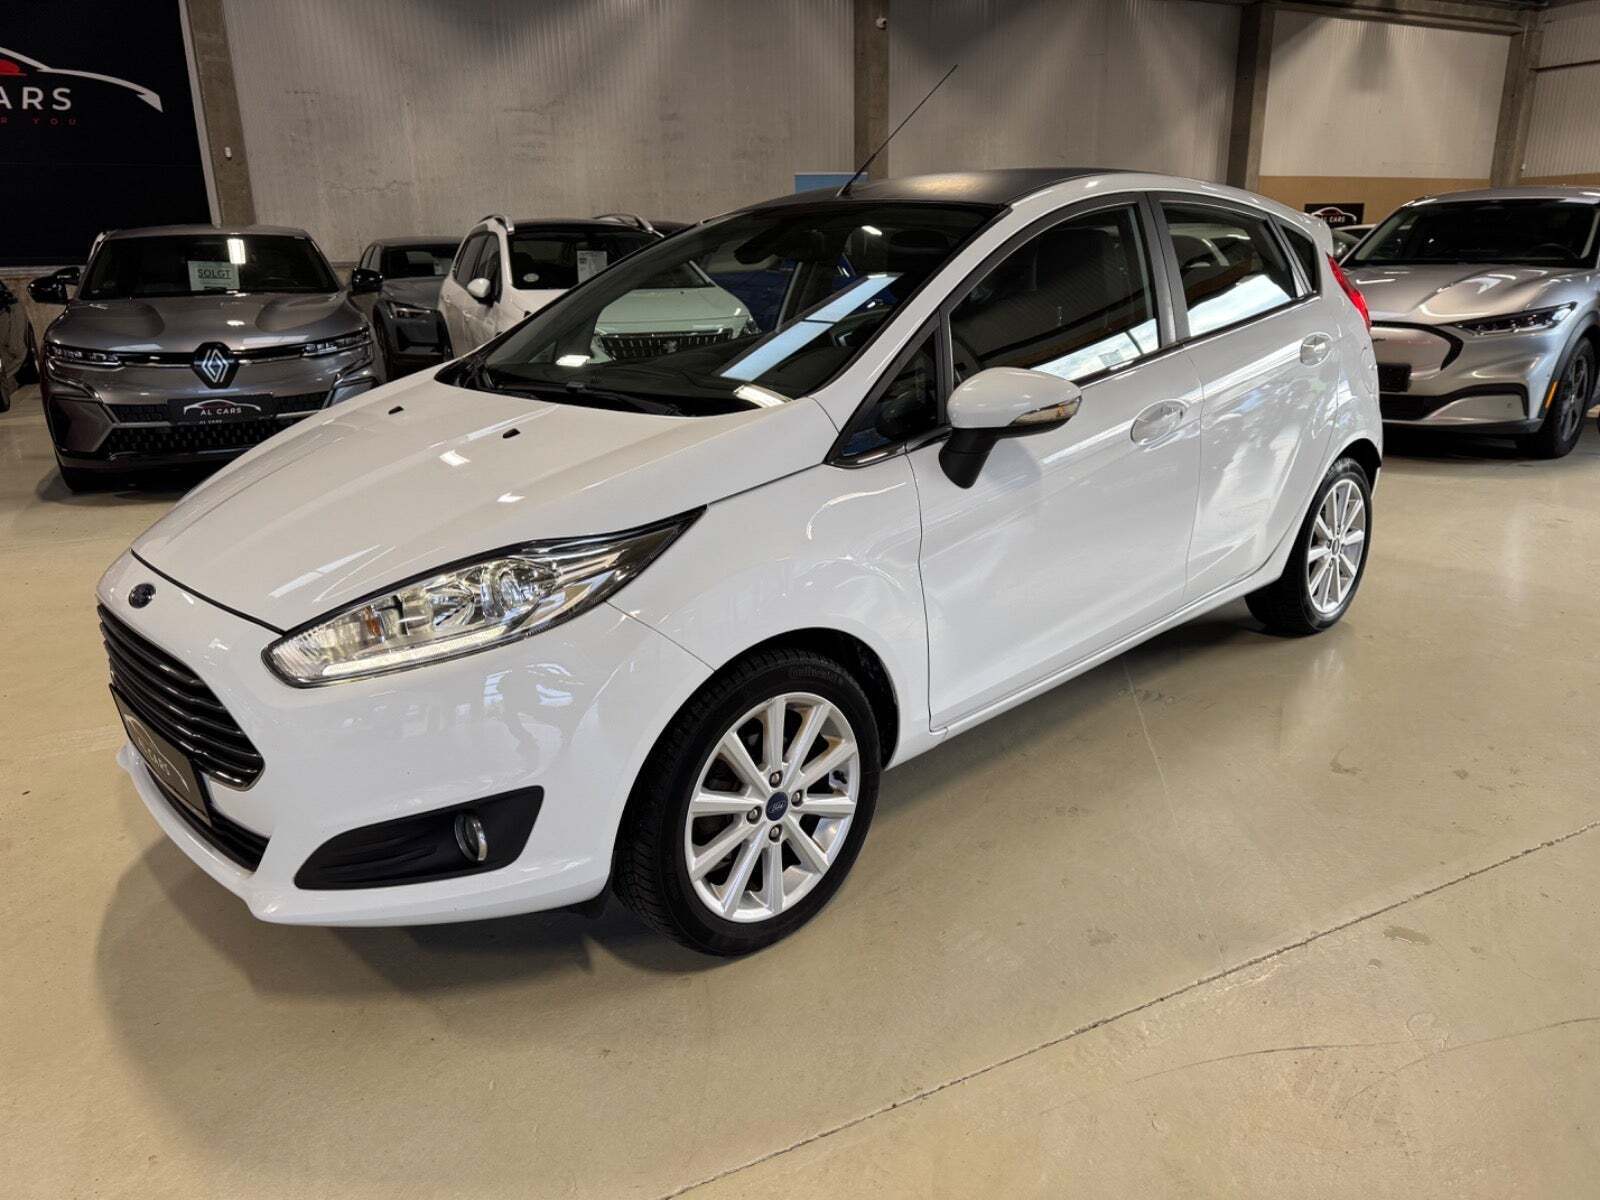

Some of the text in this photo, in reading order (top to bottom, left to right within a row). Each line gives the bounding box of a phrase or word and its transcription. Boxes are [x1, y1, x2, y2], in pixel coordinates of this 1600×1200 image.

[33, 117, 77, 126] YOU
[198, 269, 232, 279] SOLGT
[216, 407, 242, 415] CARS
